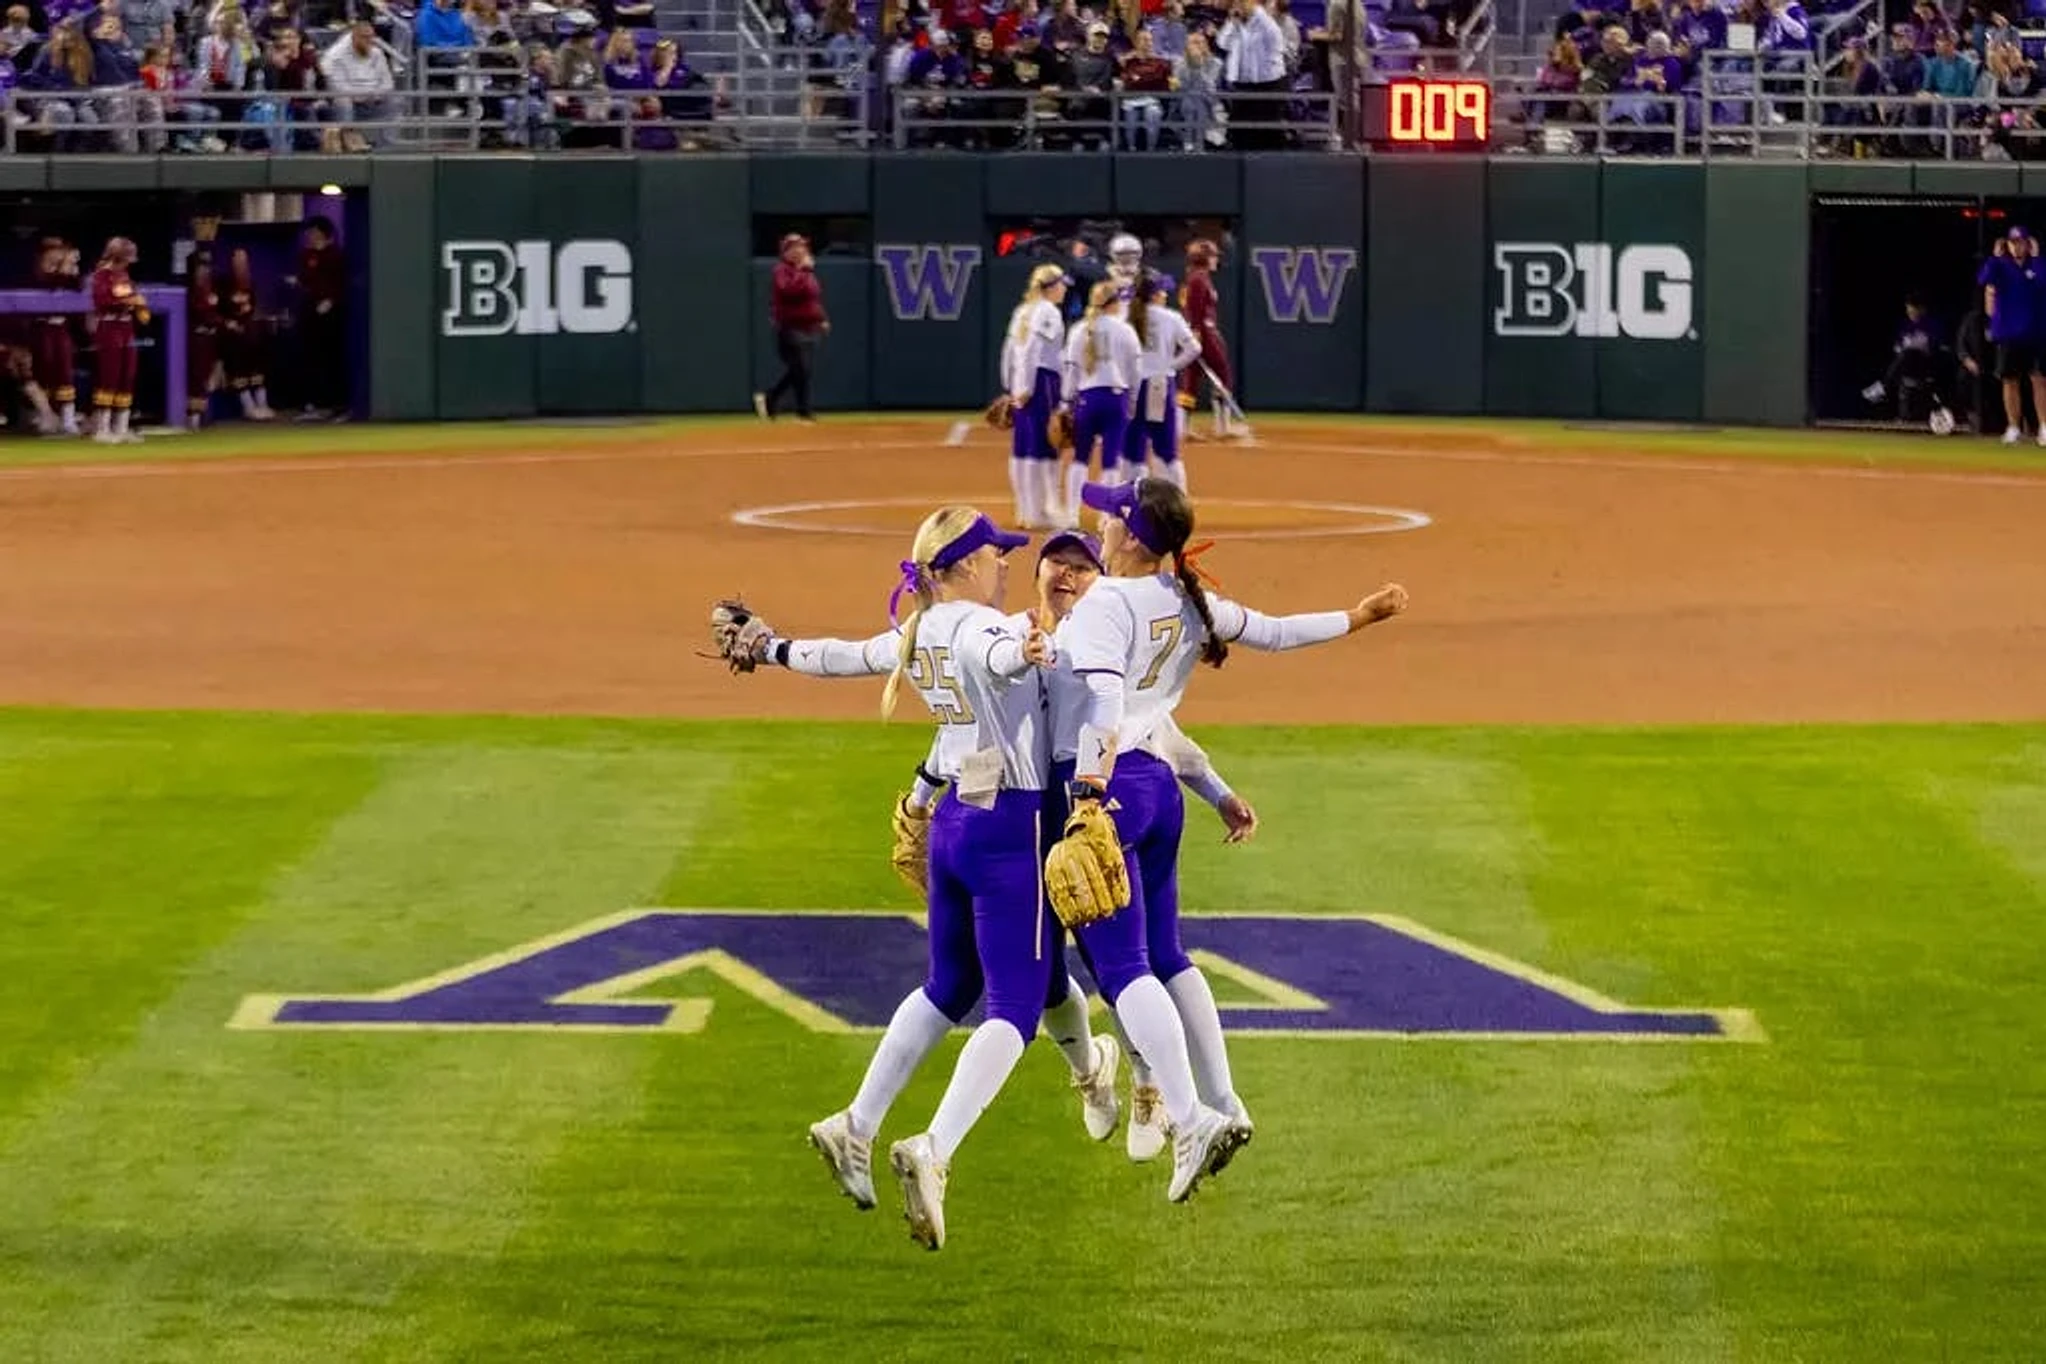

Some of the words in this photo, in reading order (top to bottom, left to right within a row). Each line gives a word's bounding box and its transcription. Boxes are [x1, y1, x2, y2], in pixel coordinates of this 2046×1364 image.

[1391, 84, 1486, 140] 009
[875, 245, 982, 320] W
[1251, 247, 1358, 323] W
[911, 646, 976, 725] 25
[1136, 614, 1183, 691] 7
